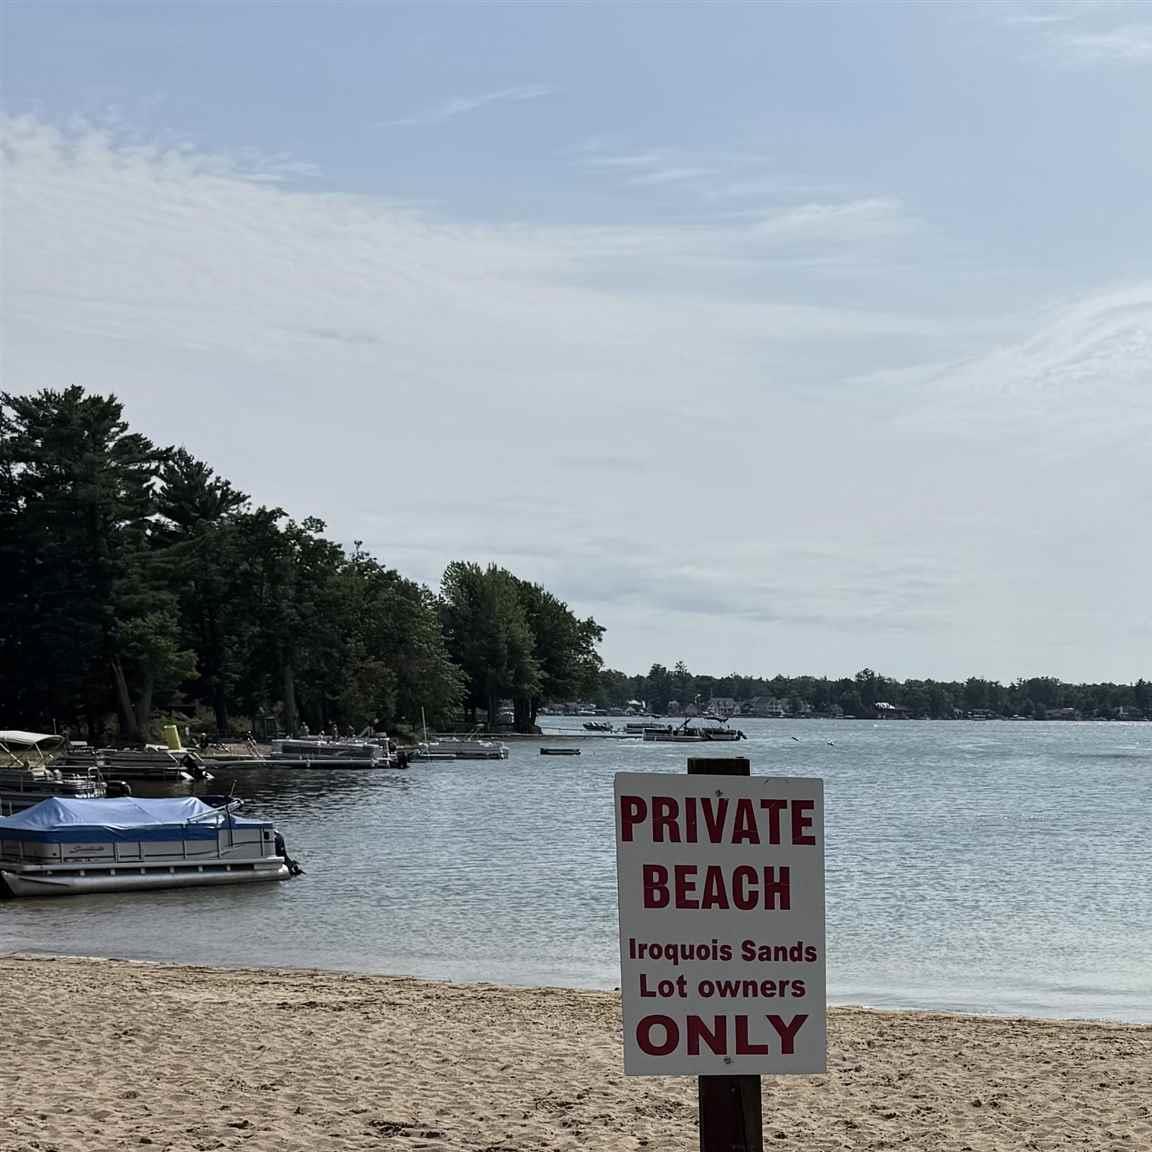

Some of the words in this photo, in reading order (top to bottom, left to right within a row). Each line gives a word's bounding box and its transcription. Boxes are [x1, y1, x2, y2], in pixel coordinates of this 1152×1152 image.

[620, 795, 816, 845] PRIVATE
[642, 864, 791, 910] BEACH
[629, 938, 733, 965] Iroquois
[741, 939, 818, 963] Sands
[640, 974, 688, 998] Lot
[698, 978, 806, 999] owners
[636, 1014, 809, 1056] ONLY
